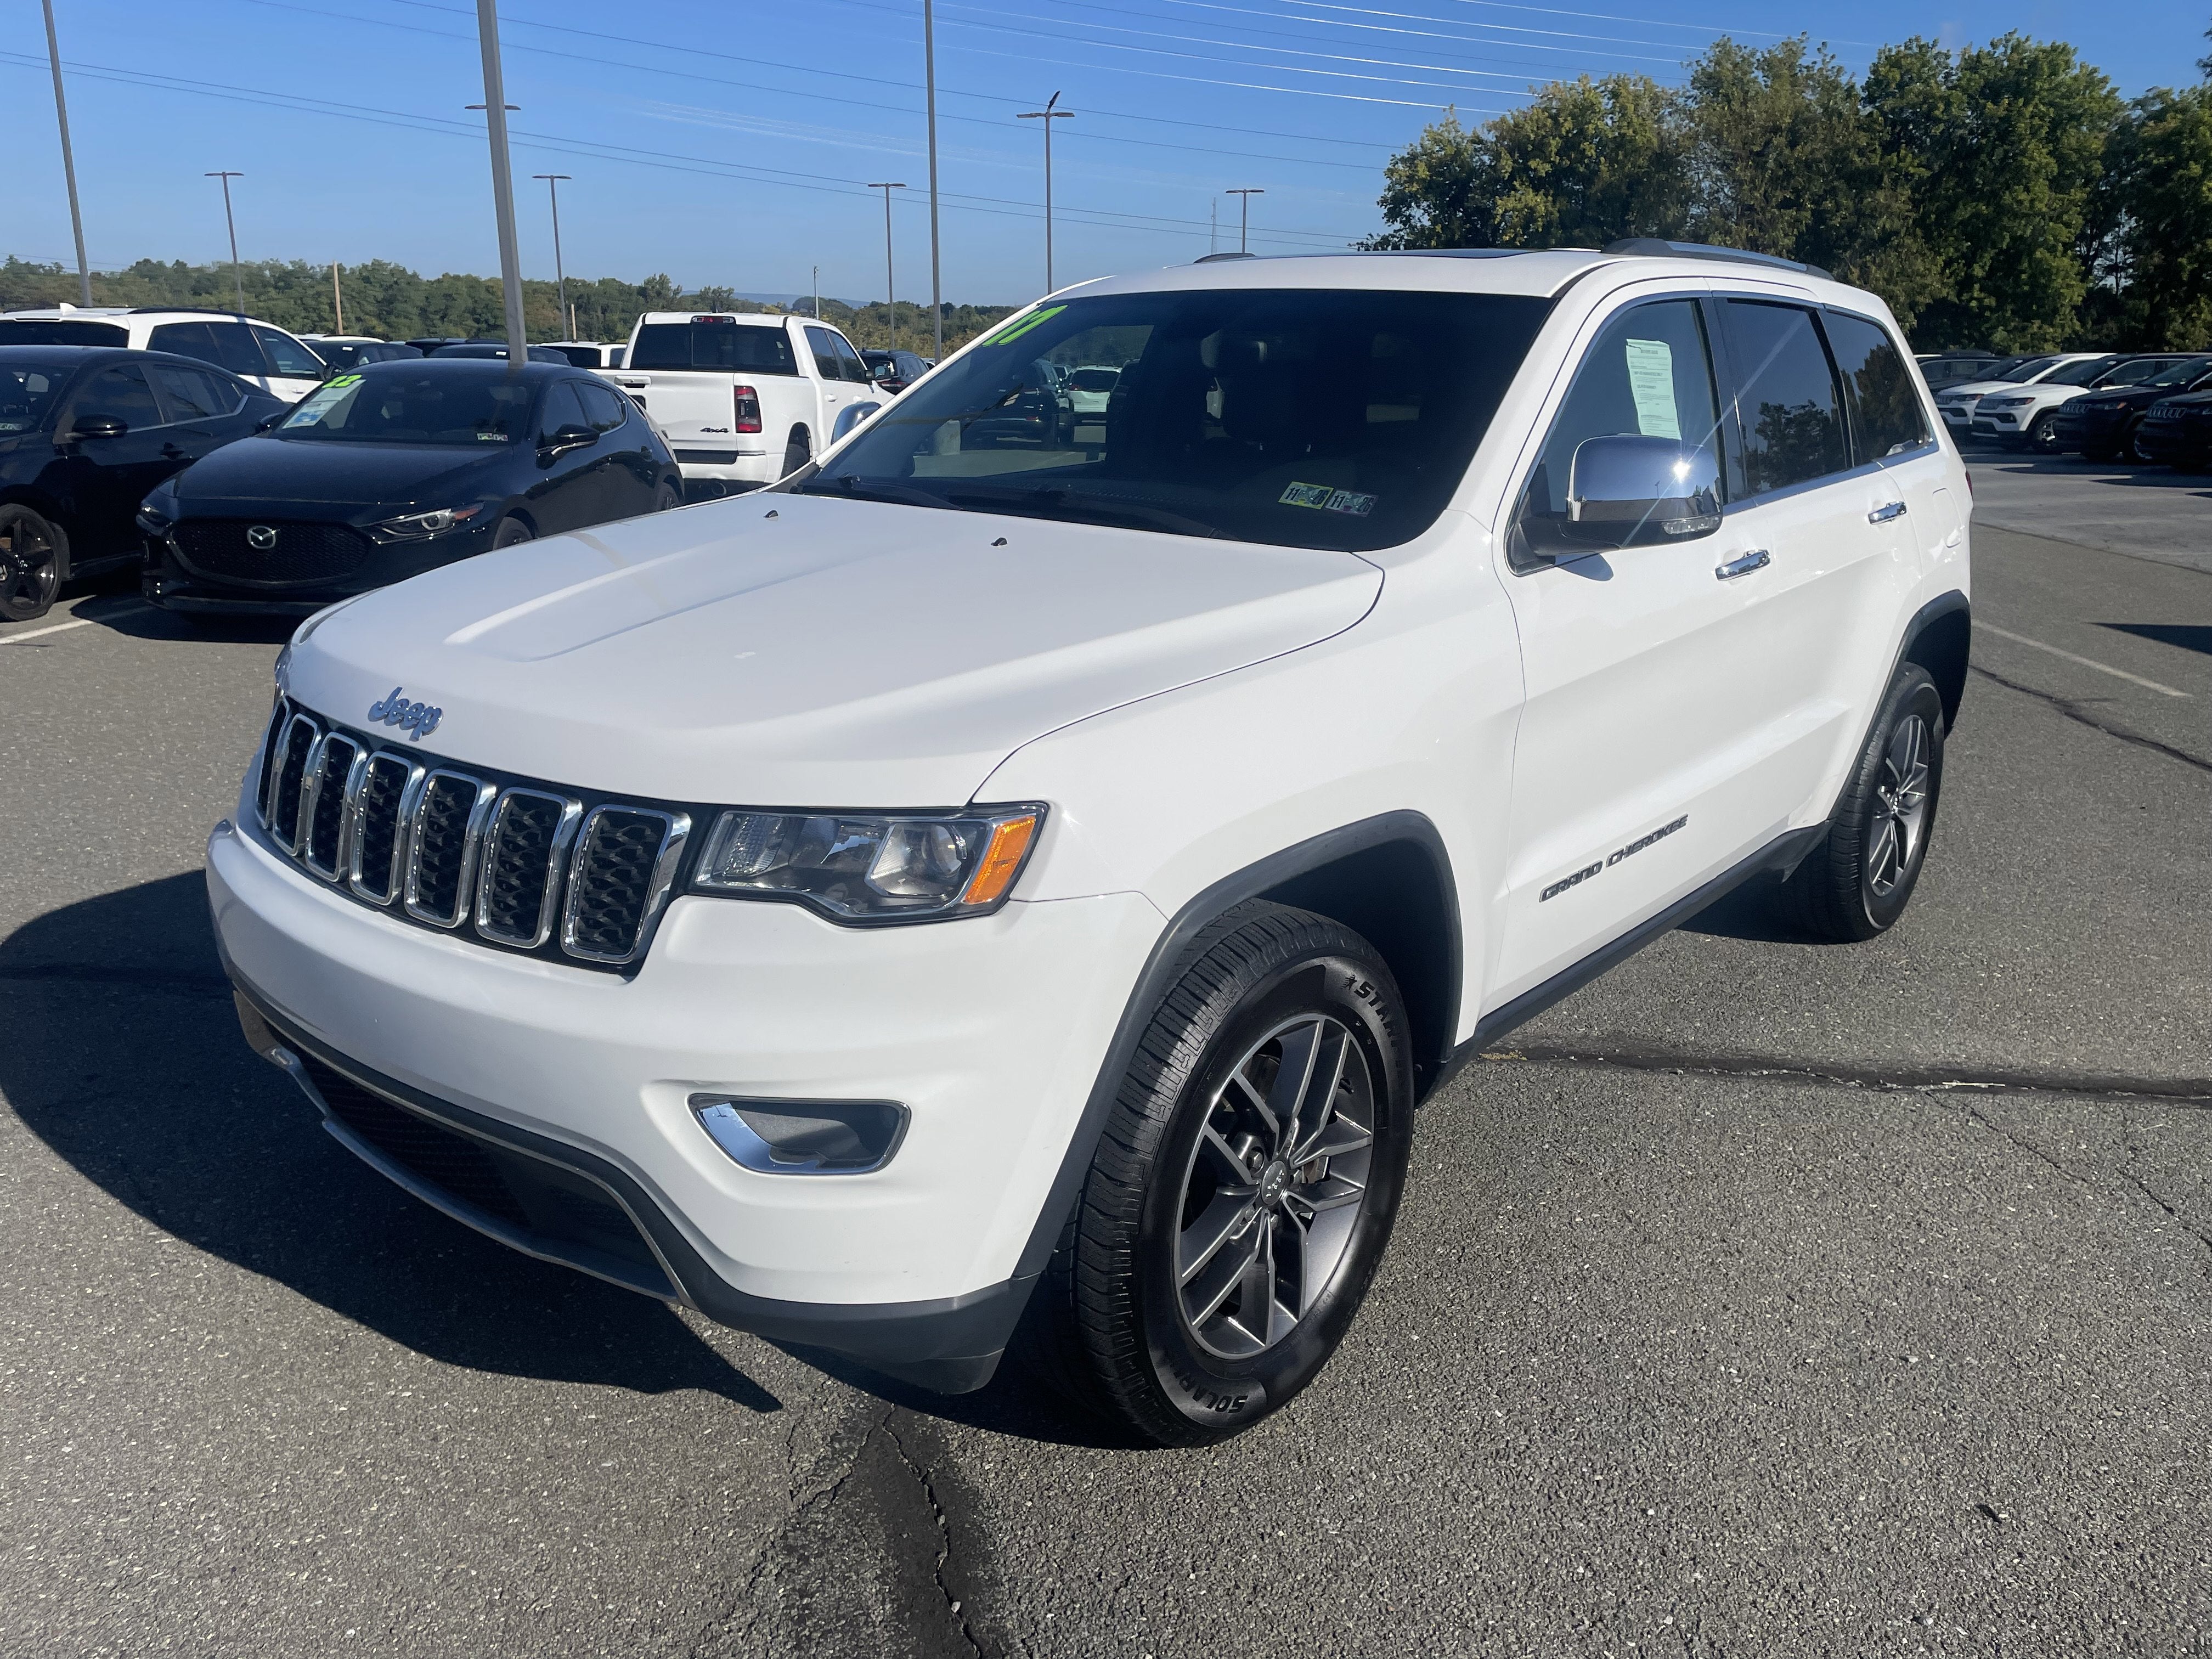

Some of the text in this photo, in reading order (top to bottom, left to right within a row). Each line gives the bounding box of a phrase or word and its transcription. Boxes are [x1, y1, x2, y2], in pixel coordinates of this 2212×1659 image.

[368, 686, 443, 742] Jeep
[1539, 813, 1689, 903] GRAND CHEROKEE
